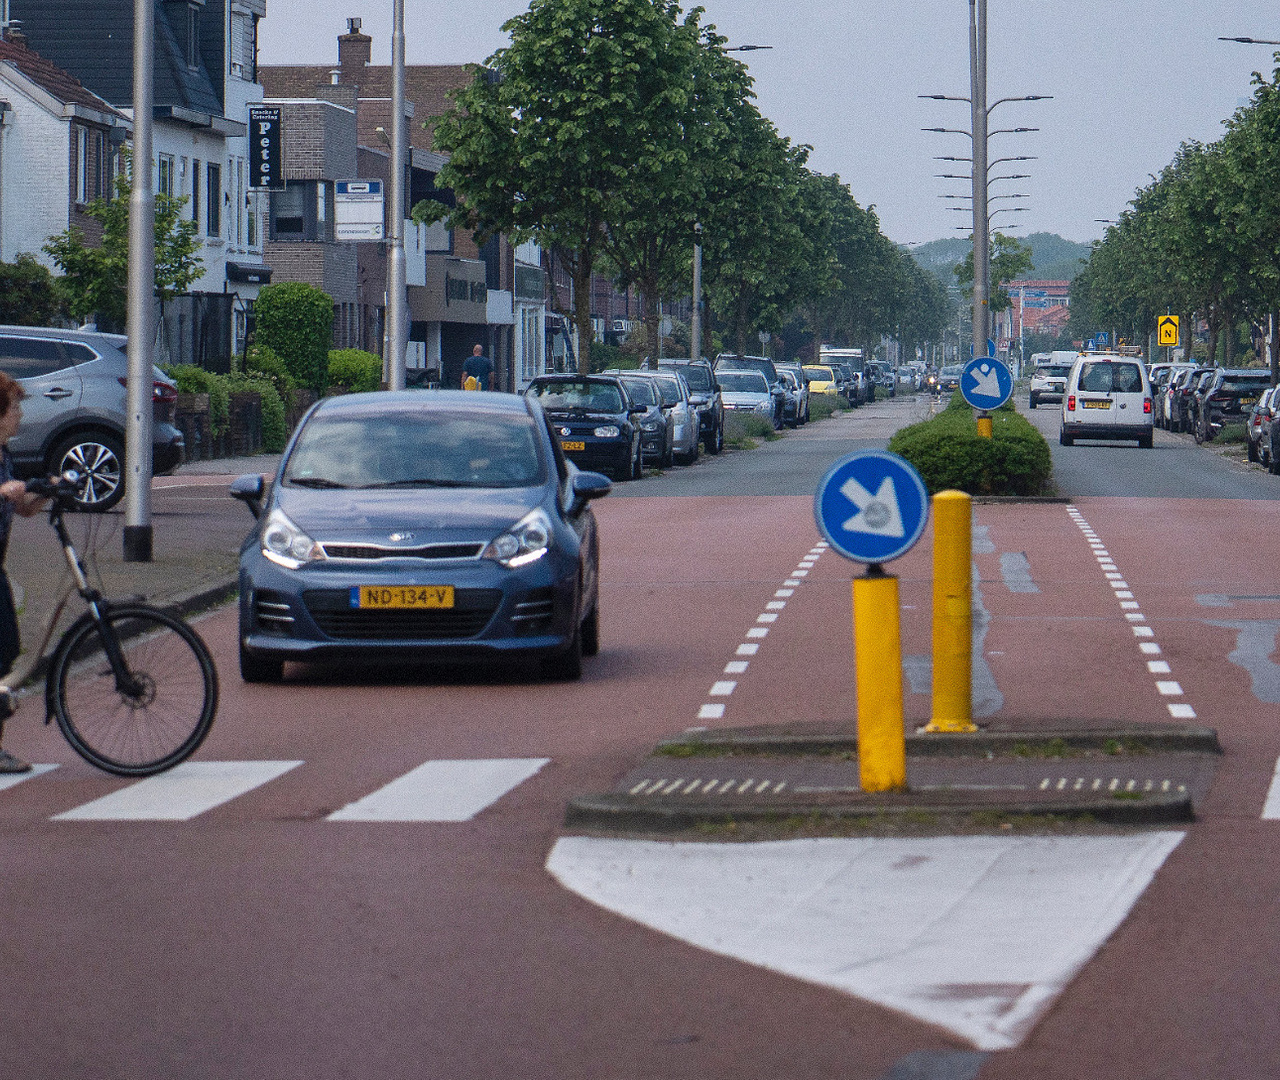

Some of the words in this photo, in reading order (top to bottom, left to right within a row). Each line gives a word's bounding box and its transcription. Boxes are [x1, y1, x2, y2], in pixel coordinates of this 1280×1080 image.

[259, 122, 271, 186] Peter
[1164, 330, 1172, 338] N
[367, 589, 447, 605] ND-134-V
